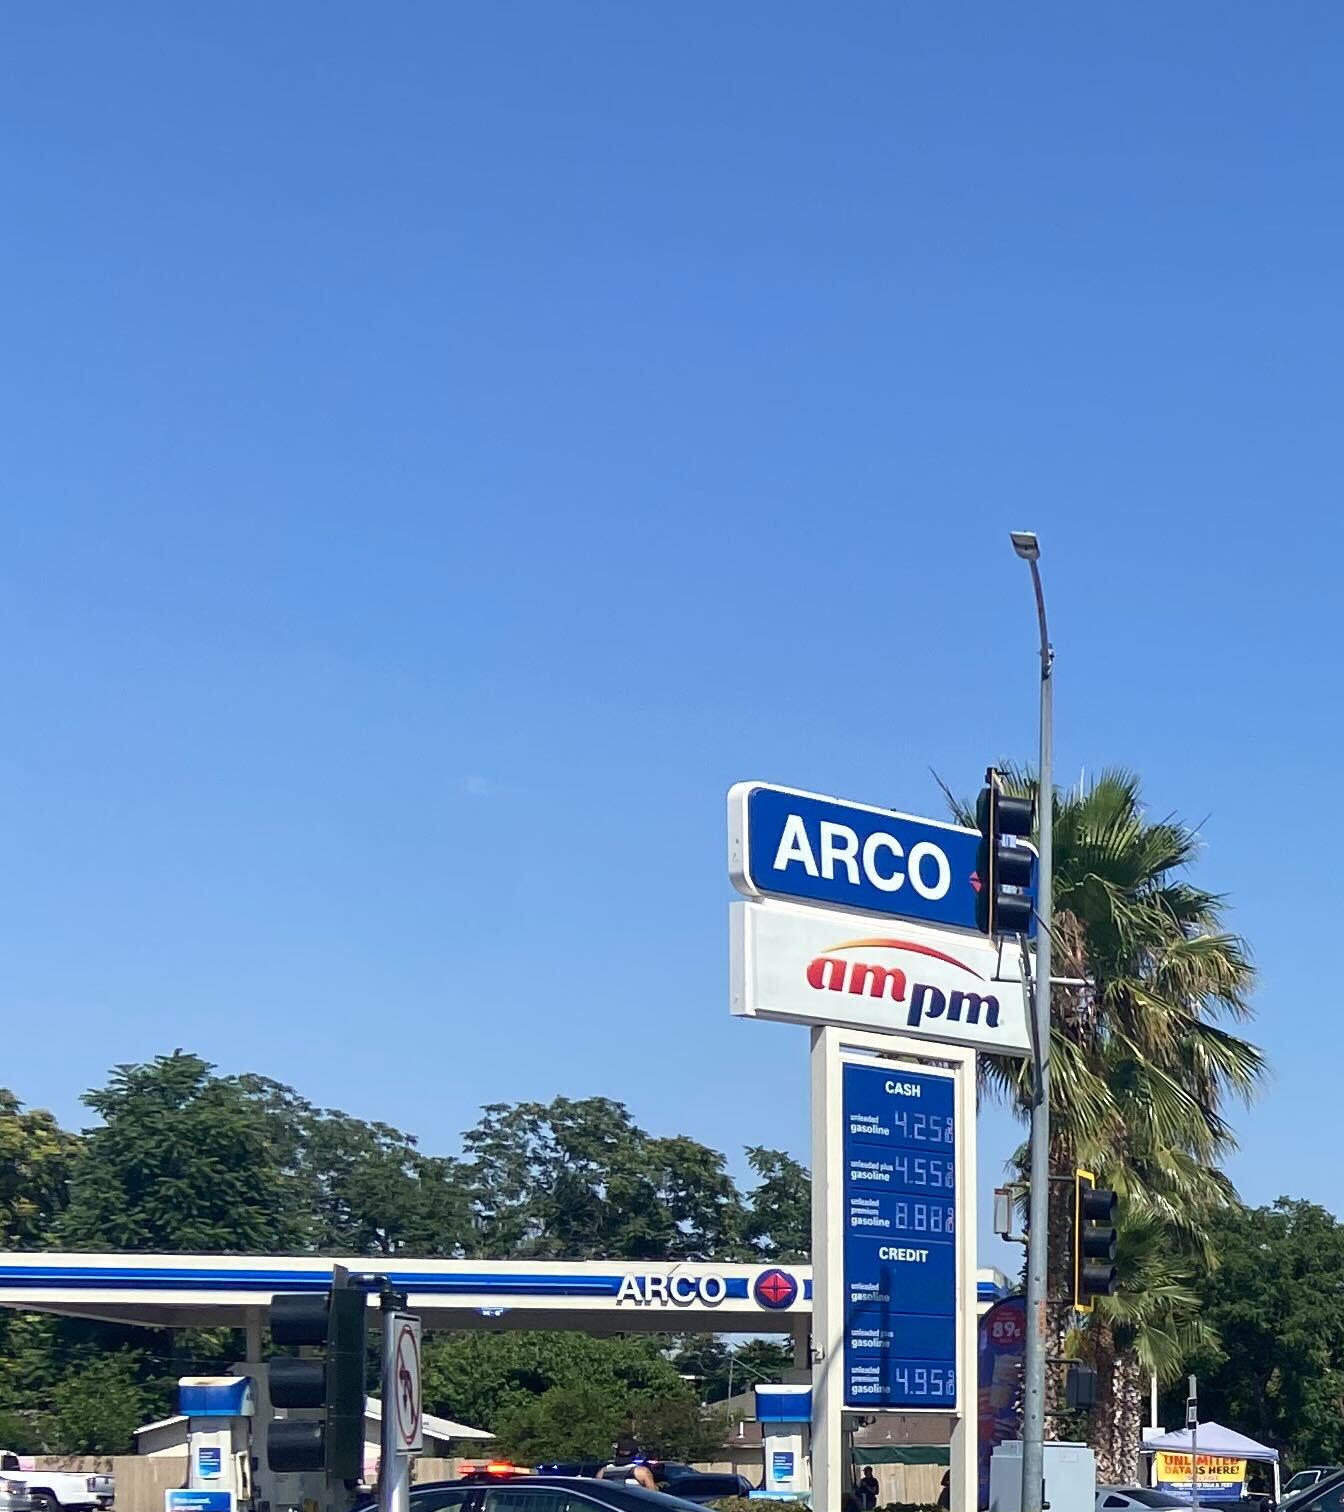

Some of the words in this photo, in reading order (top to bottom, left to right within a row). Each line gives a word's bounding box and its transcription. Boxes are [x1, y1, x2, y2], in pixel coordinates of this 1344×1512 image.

[772, 814, 951, 900] ARCO
[806, 957, 1000, 1028] ampm
[885, 1080, 921, 1098] CASH
[850, 1123, 890, 1136] gasoline
[850, 1160, 880, 1169] unleaded
[880, 1163, 894, 1172] plus
[850, 1169, 890, 1182] gasoline
[850, 1198, 880, 1207] unleaded
[850, 1216, 890, 1228] gasoline
[878, 1246, 929, 1263] CREDIT
[615, 1272, 727, 1307] ARCO
[851, 1291, 890, 1303] gasoline
[851, 1338, 890, 1349] gasoline
[851, 1383, 891, 1396] gasoline
[1208, 1466, 1240, 1475] HERE!
